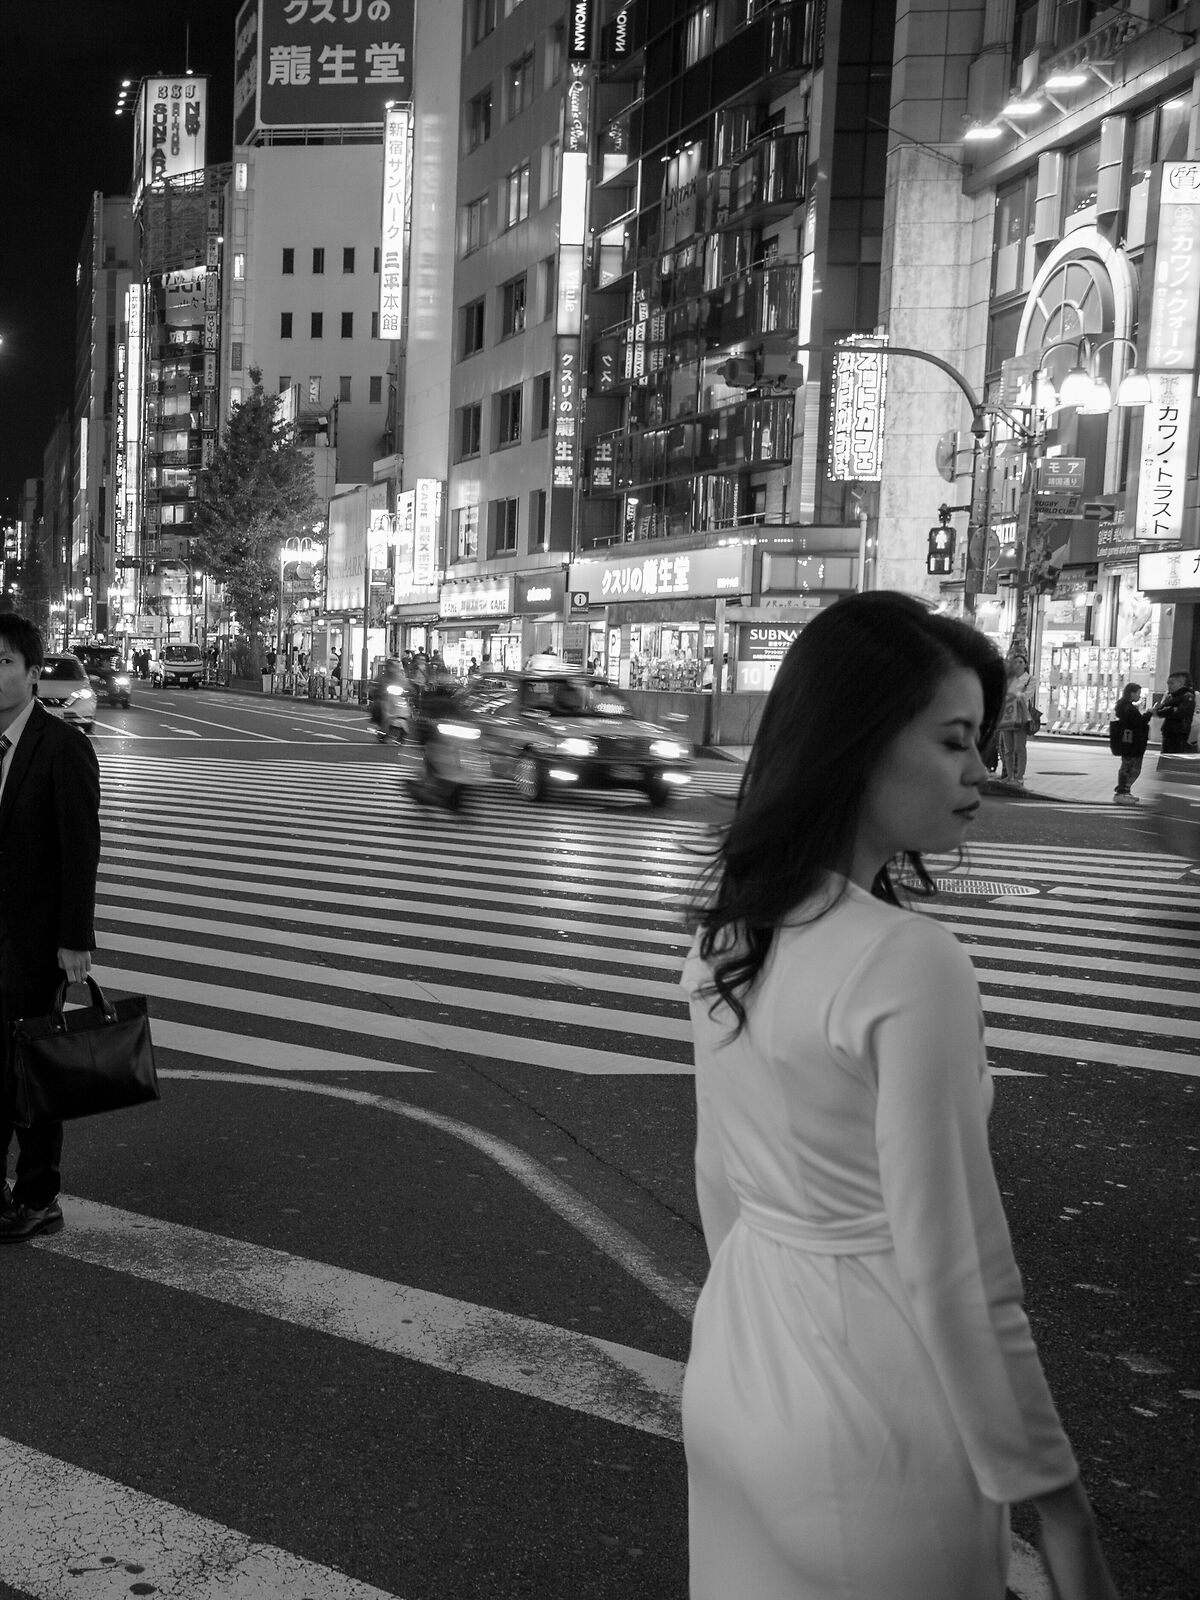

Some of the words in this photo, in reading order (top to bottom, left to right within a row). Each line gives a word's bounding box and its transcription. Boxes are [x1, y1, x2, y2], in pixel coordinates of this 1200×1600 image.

[575, 3, 587, 51] WOMAN
[267, 42, 406, 86] 龍生堂
[382, 251, 400, 332] 三平本館
[1048, 462, 1081, 474] モア
[1152, 406, 1179, 535] カワノ・トラスト
[602, 555, 690, 596] クスリの龍生堂
[741, 667, 762, 685] 10
